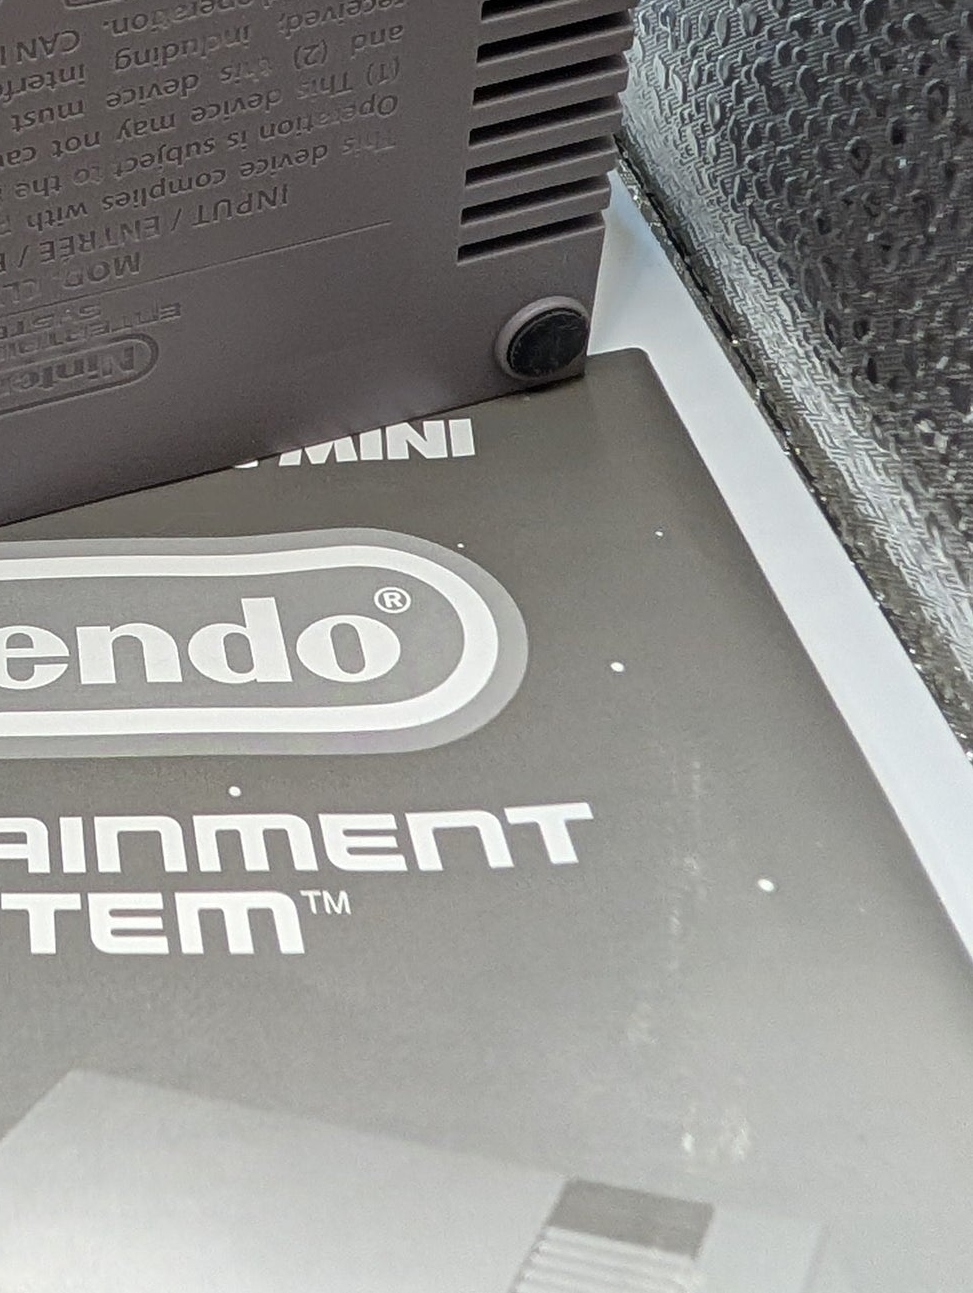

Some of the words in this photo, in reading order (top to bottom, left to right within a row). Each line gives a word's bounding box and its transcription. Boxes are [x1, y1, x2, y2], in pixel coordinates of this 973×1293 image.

[17, 26, 79, 62] CAN
[114, 18, 250, 77] including
[292, 39, 327, 70] (2)
[350, 24, 402, 55] and
[296, 69, 353, 104] This
[365, 56, 400, 87] (1)
[106, 71, 198, 114] device
[190, 87, 281, 128] device
[12, 98, 82, 133] must
[116, 108, 174, 141] may
[258, 88, 398, 145] Operation
[51, 129, 99, 159] not
[113, 132, 214, 179] subject
[226, 129, 247, 153] is
[341, 125, 396, 160] This
[75, 164, 100, 187] to
[239, 142, 327, 184] device
[15, 173, 60, 203] the
[102, 163, 225, 215] complies
[192, 183, 287, 227] INPUT
[27, 201, 85, 233] with
[40, 214, 159, 267] ENTRÉE
